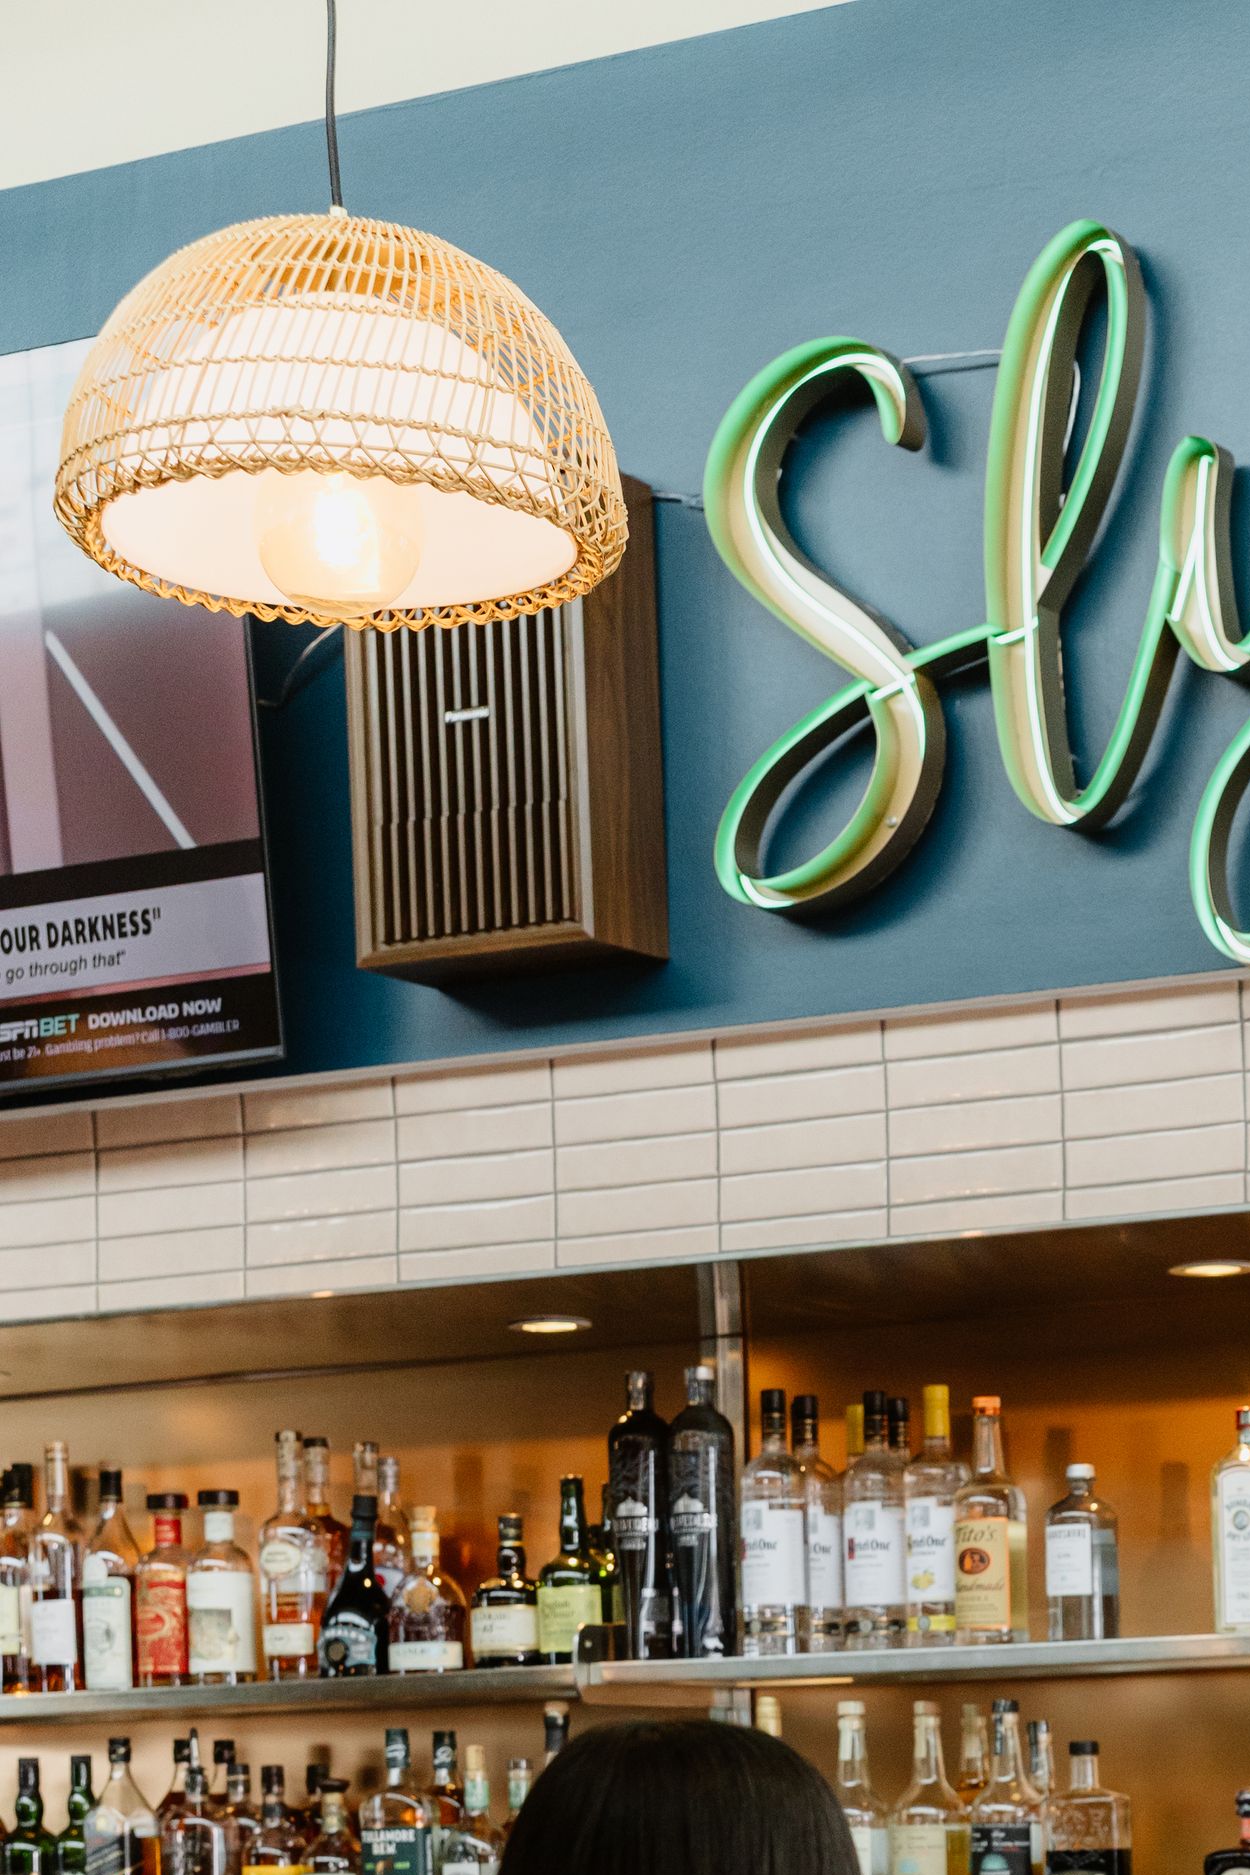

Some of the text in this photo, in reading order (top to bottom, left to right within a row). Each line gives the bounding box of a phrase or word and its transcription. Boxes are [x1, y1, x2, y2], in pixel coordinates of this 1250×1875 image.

[47, 907, 161, 949] DARKNESS"
[6, 968, 24, 984] go
[29, 955, 88, 976] through
[87, 1002, 180, 1030] DOWNLOAD
[182, 997, 222, 1017] NOW
